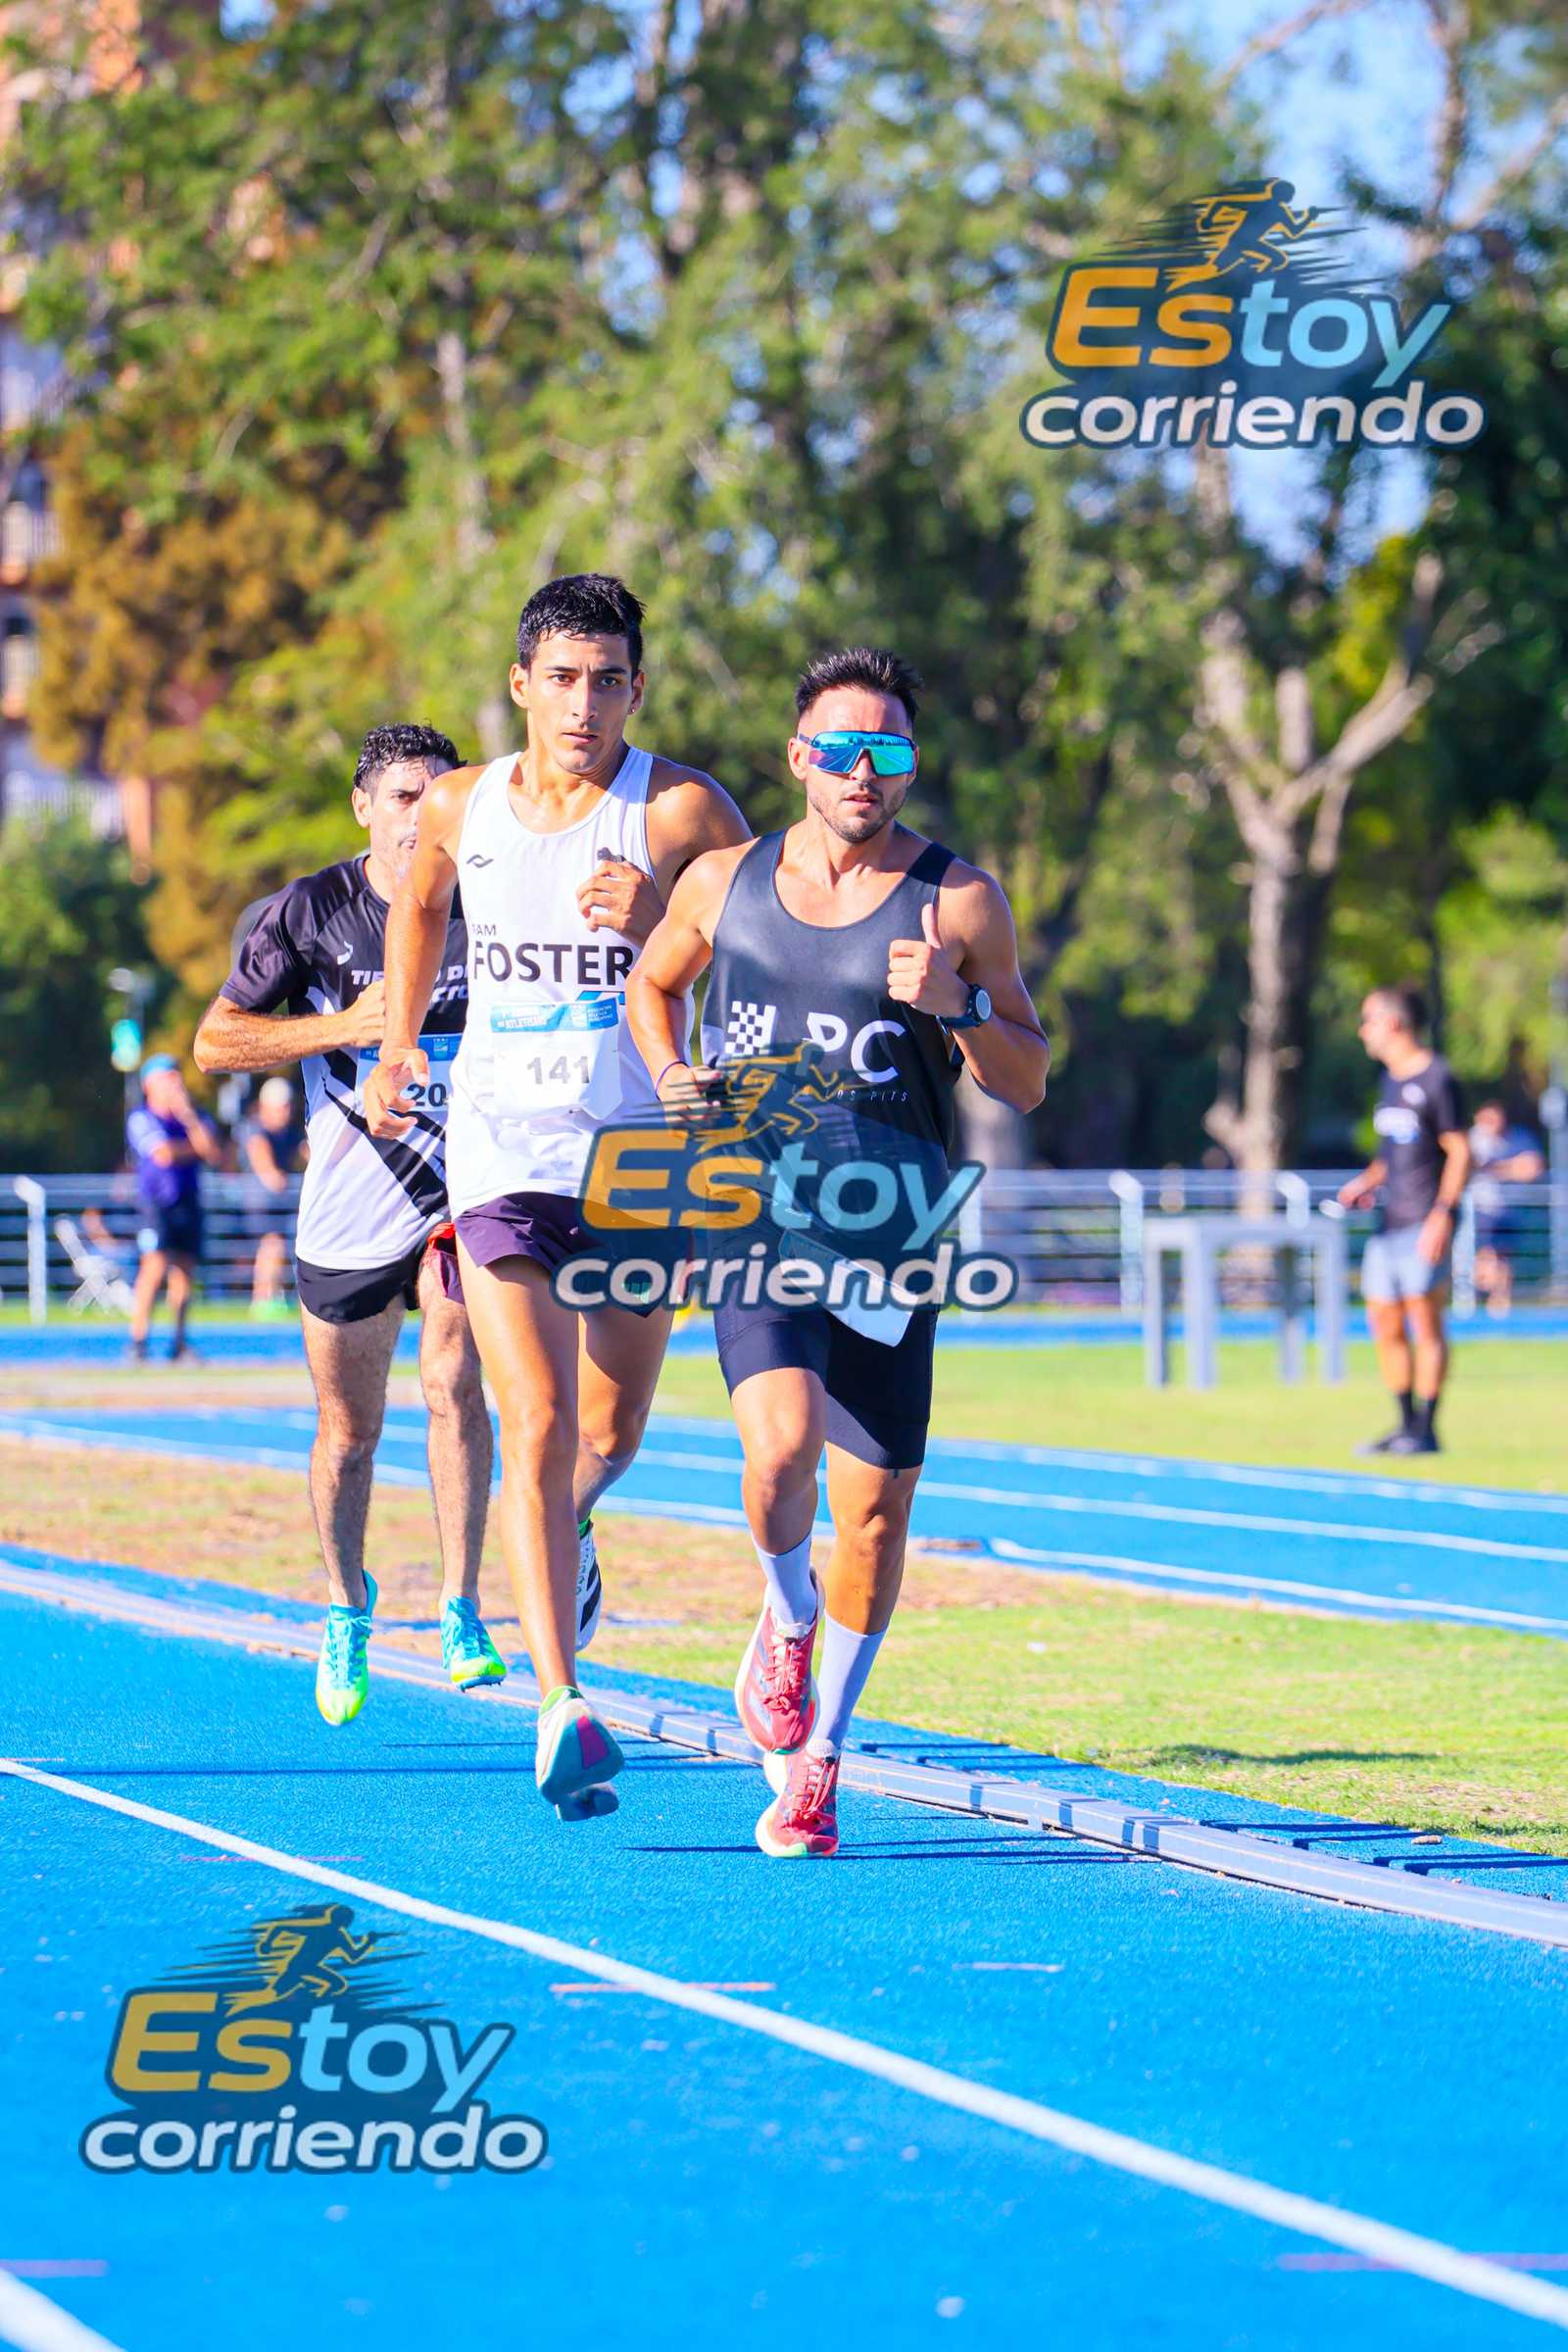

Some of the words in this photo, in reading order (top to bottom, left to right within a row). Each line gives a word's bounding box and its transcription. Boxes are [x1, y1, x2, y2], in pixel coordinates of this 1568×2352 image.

[472, 924, 497, 937] AM
[473, 941, 634, 986] FOSTER
[526, 1055, 590, 1085] 141
[869, 1091, 907, 1102] PITS
